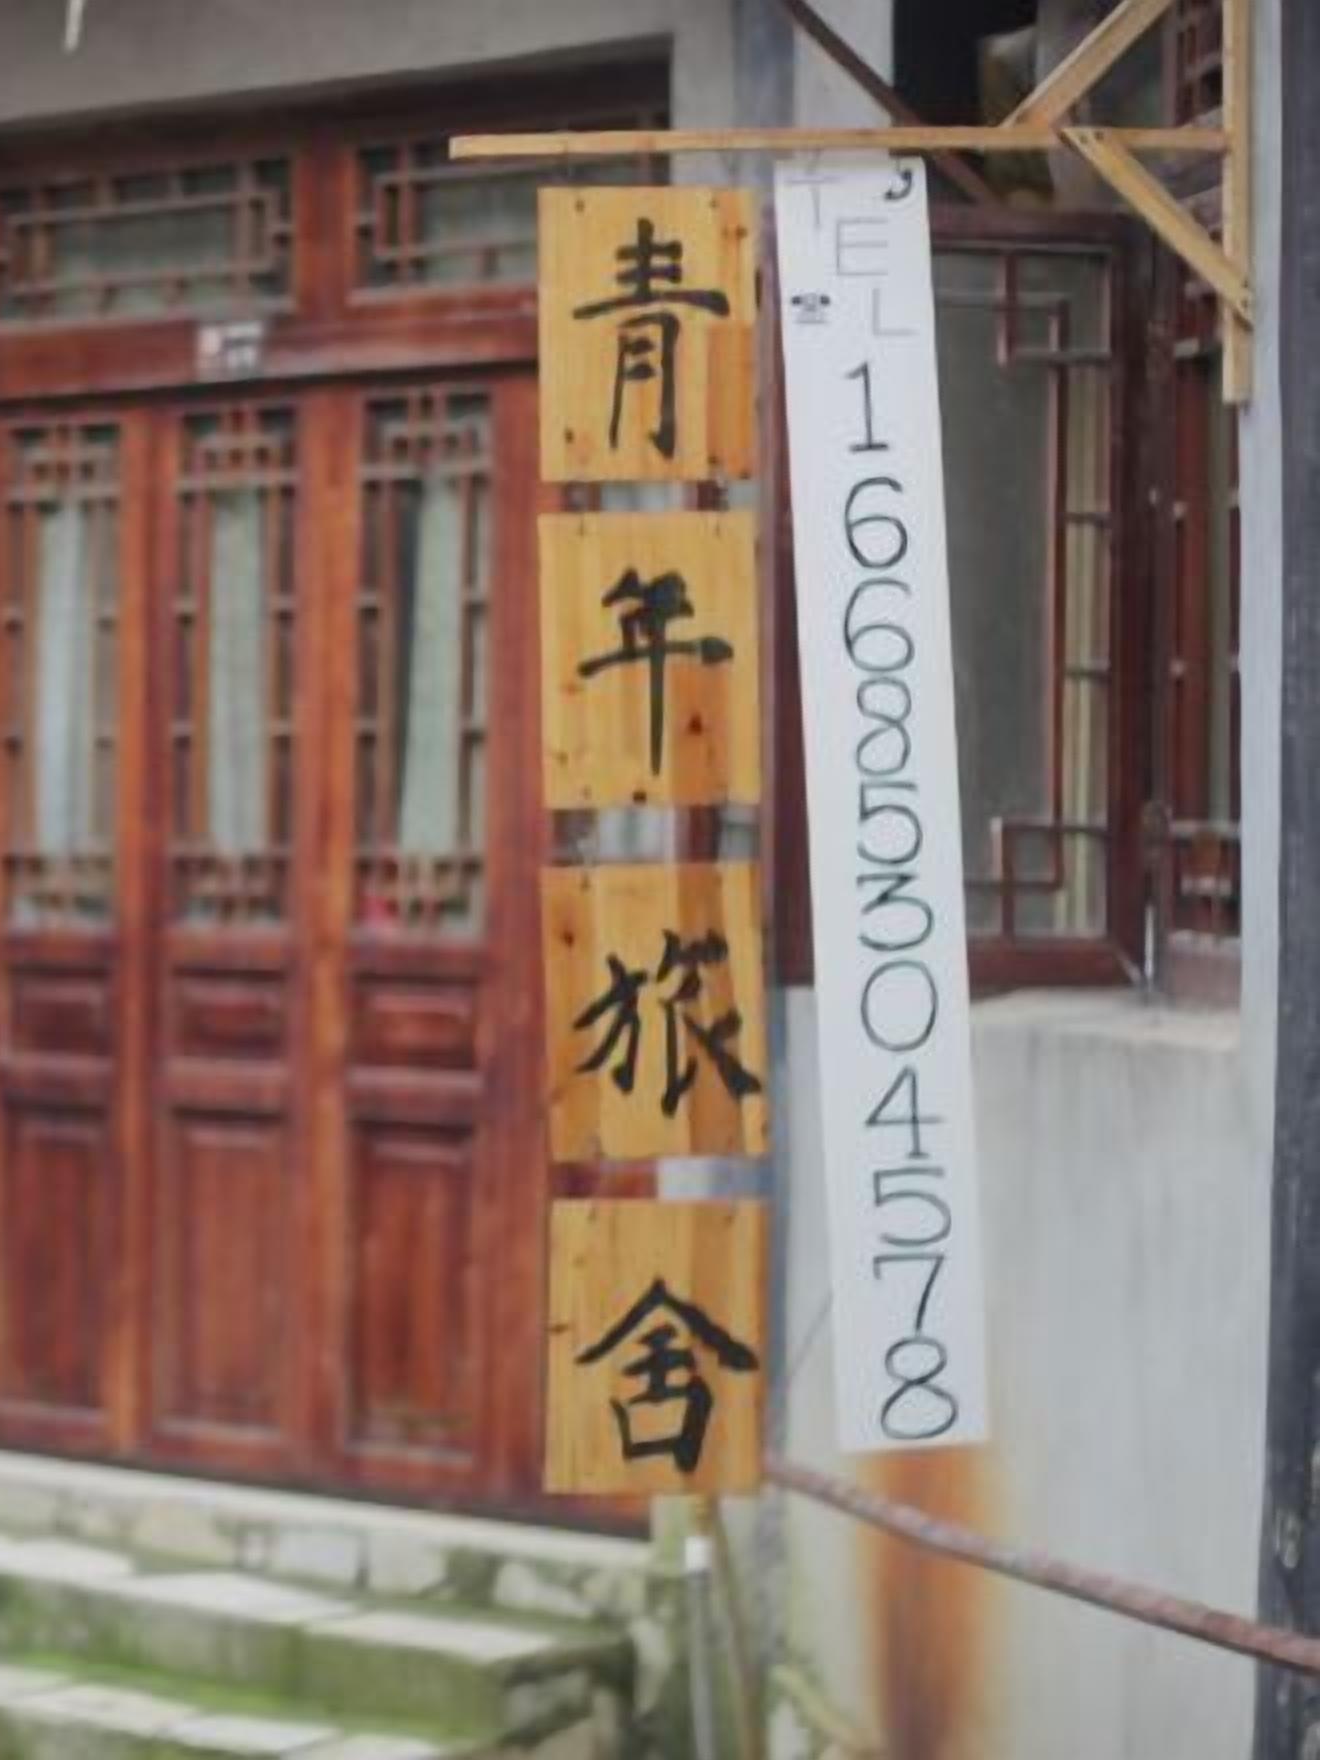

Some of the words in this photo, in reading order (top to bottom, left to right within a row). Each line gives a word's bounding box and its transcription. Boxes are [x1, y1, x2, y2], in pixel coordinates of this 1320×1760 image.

[785, 174, 919, 336] TEL
[571, 216, 762, 1473] 青年旅舍
[843, 360, 959, 1440] 16685304578
